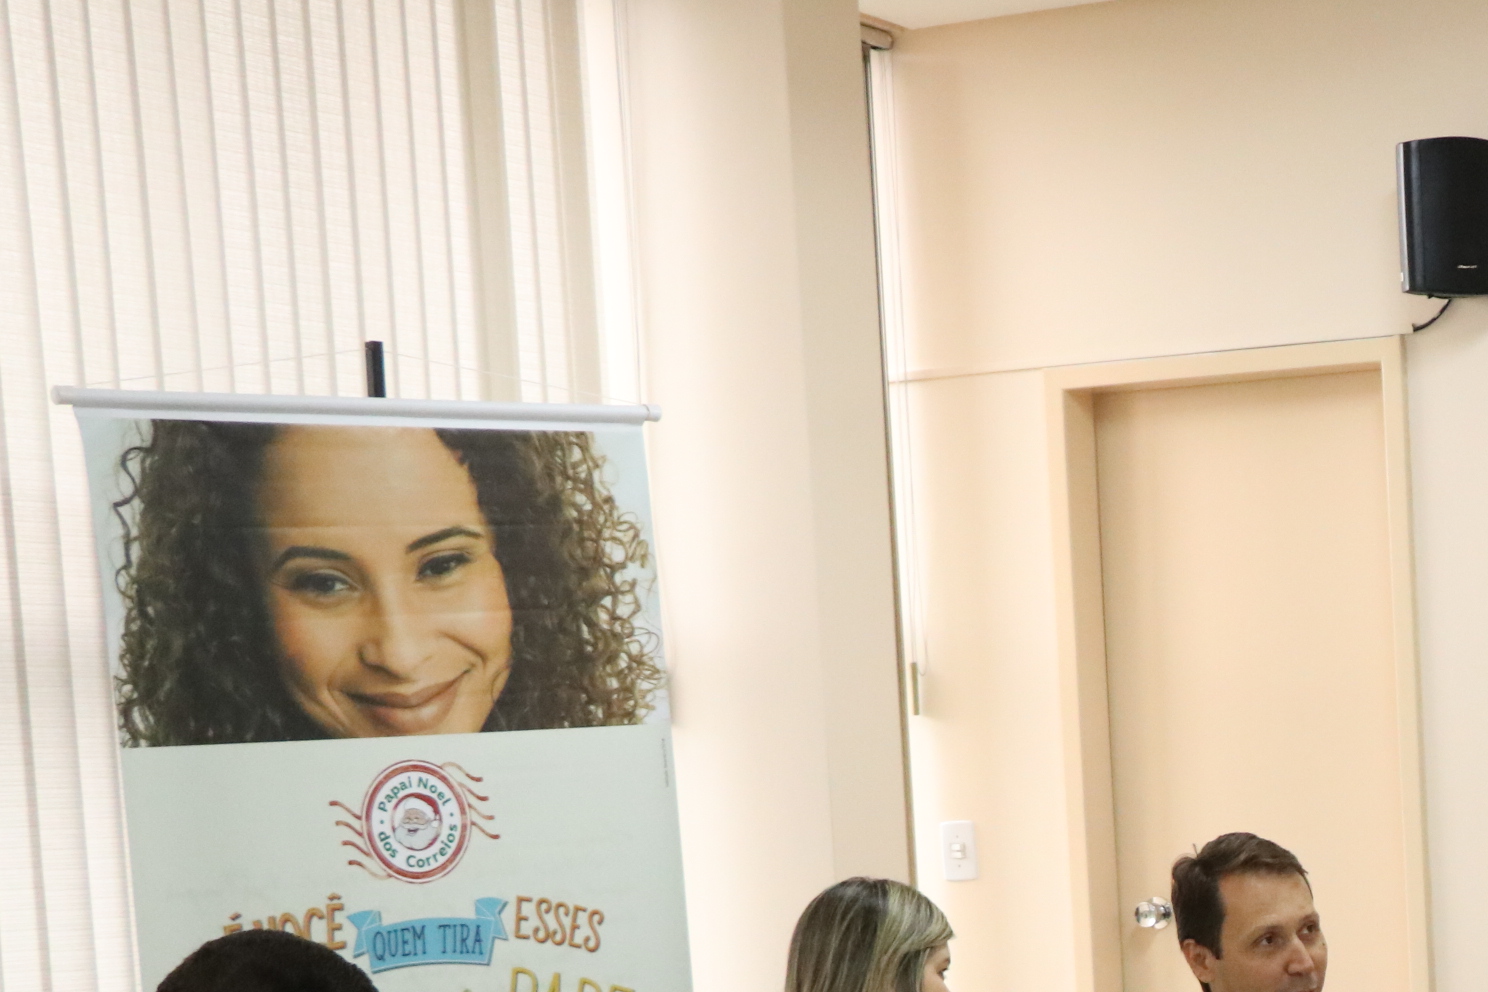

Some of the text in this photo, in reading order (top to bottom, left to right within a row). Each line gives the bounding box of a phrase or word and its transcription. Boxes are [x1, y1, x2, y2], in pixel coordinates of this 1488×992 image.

[377, 776, 452, 812] Papai Noel
[377, 823, 458, 869] dos Correios
[372, 925, 428, 962] QUEM
[437, 923, 484, 957] TIRA
[514, 895, 606, 953] ESSES
